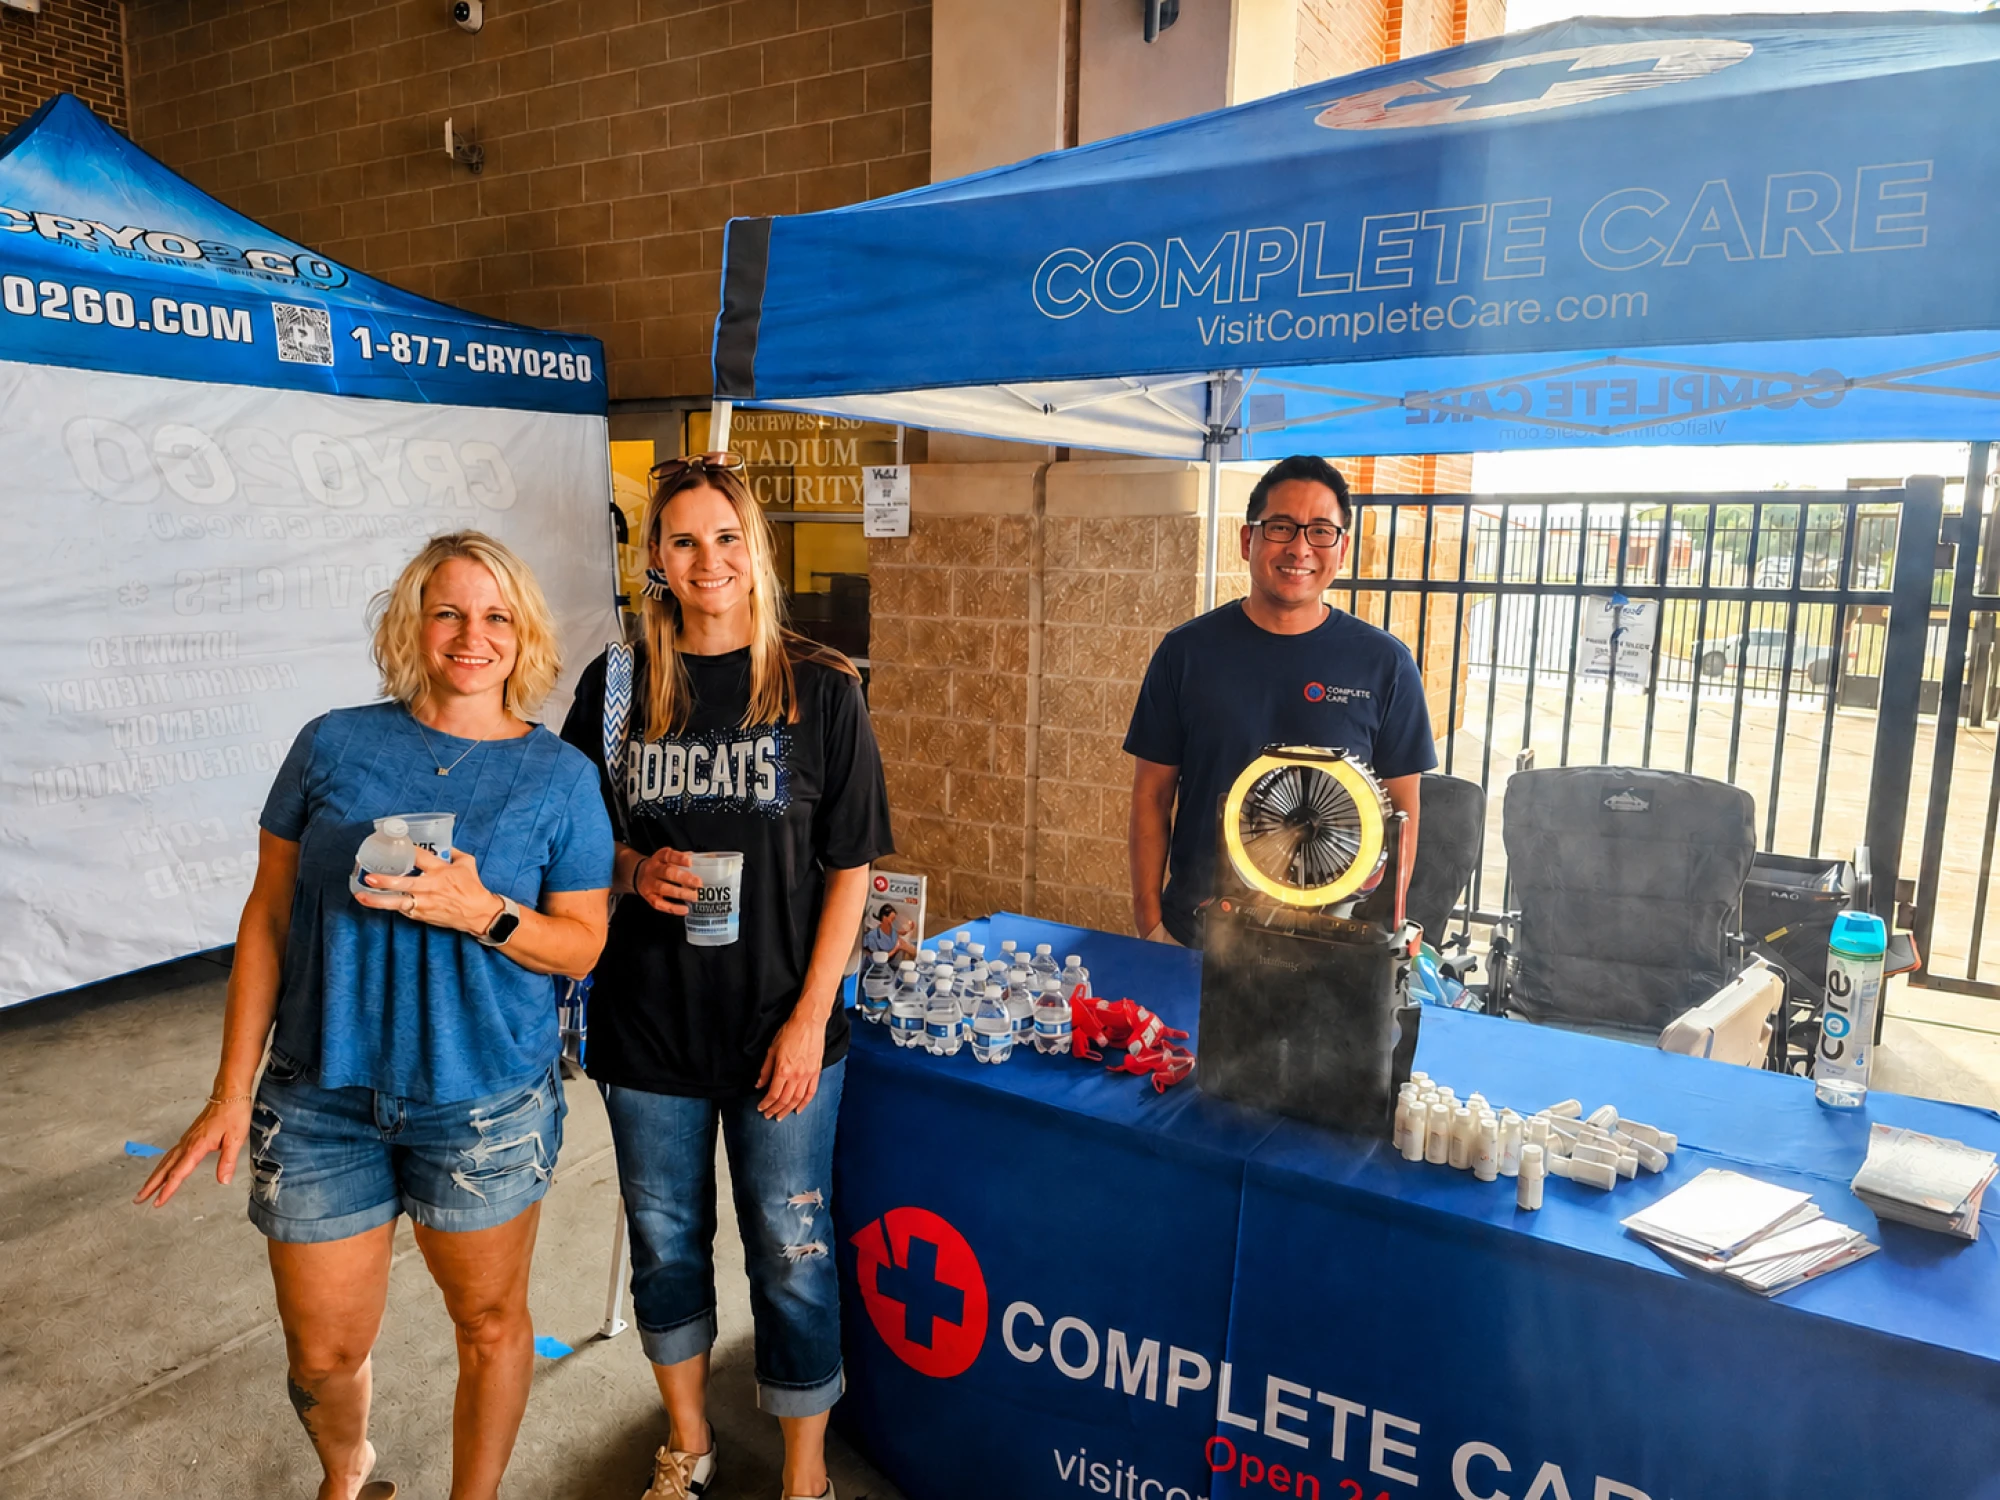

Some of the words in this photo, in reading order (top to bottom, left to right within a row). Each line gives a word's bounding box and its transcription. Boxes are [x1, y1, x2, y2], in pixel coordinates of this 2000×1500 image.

[1032, 197, 1552, 319] COMPLETE
[1578, 159, 1934, 273] CARE
[1197, 290, 1649, 346] VisitCompleteCare.com
[744, 475, 865, 505] CURITY
[1326, 686, 1371, 699] COMPLETE
[627, 735, 777, 808] BOBCATS
[697, 886, 731, 901] BOYS
[1821, 969, 1852, 1061] core
[1002, 1301, 1421, 1487] COMPLETE
